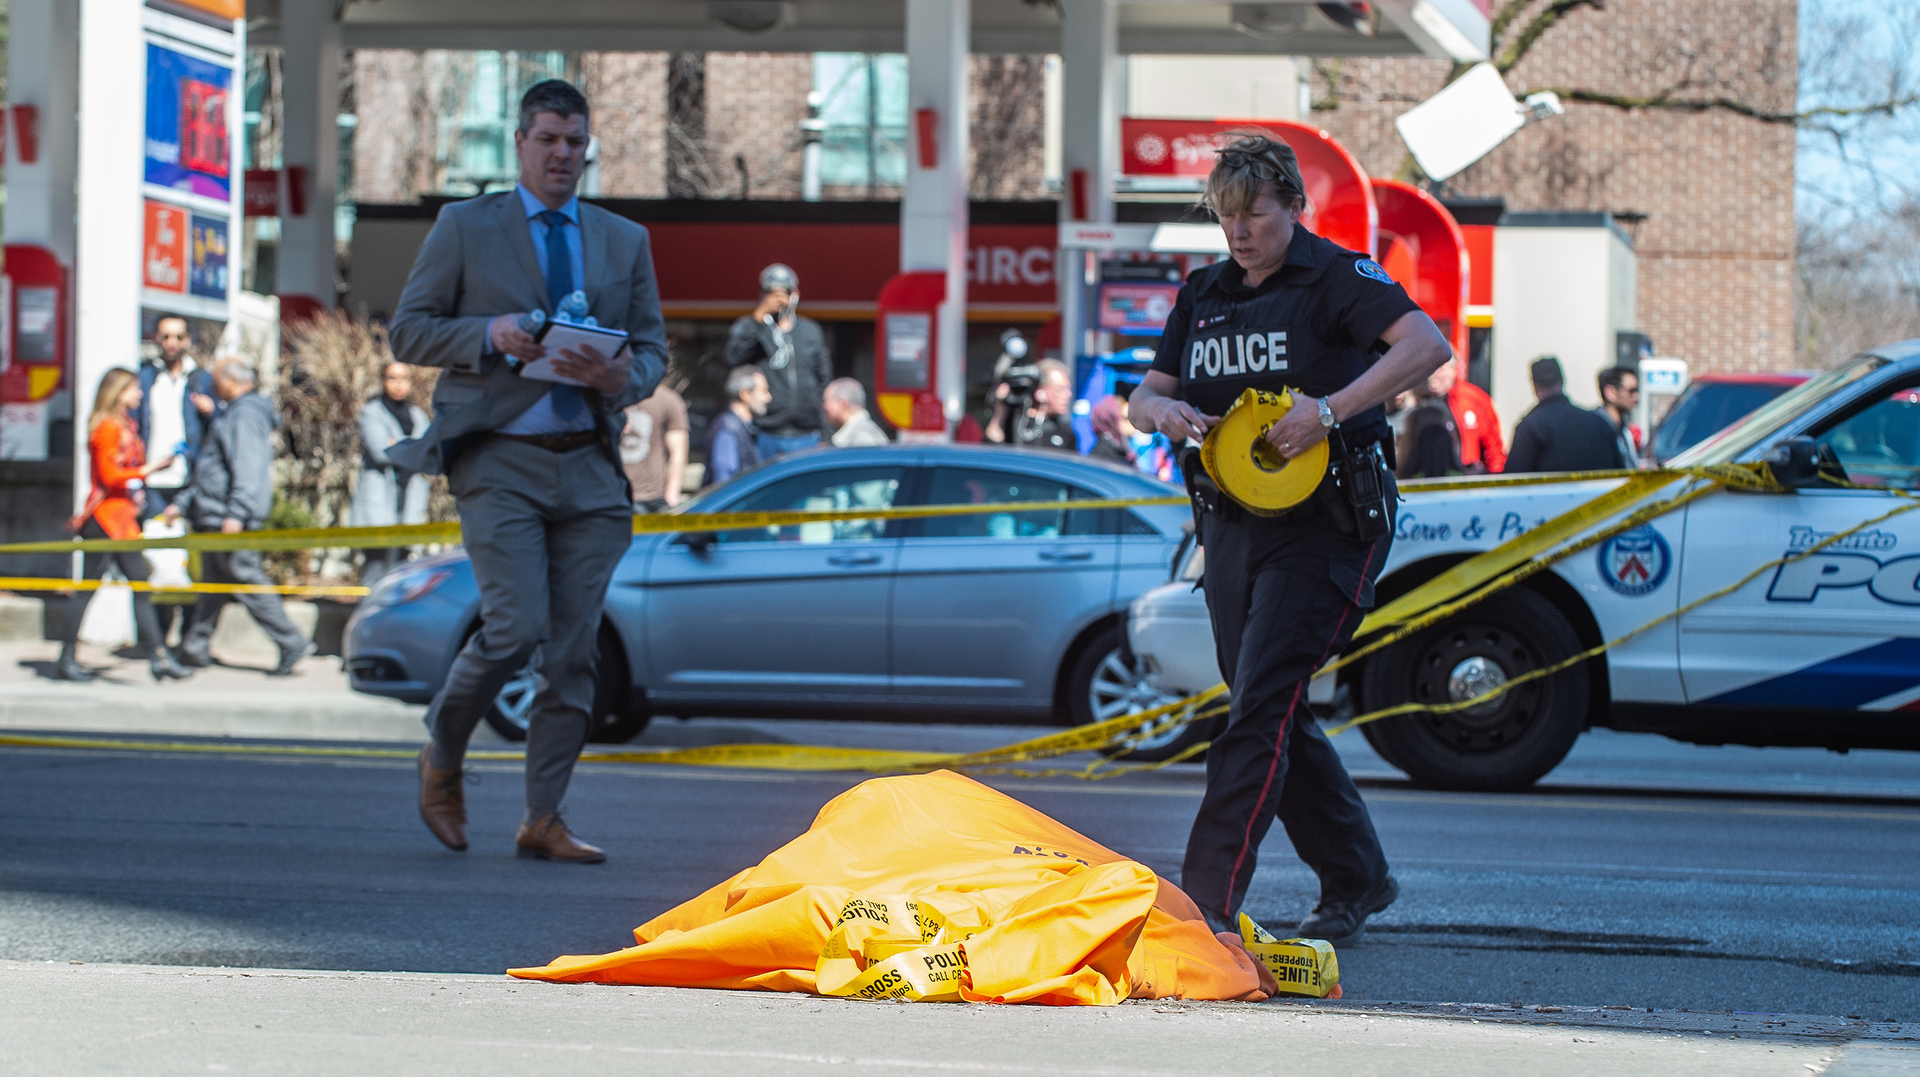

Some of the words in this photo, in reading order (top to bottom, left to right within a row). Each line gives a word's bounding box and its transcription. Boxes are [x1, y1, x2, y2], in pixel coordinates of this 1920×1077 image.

[1189, 331, 1288, 379] POLICE
[1396, 512, 1451, 541] Serve
[1462, 515, 1486, 541] &
[923, 950, 967, 970] POLIC
[860, 969, 902, 998] CROSS
[928, 971, 949, 983] CALL
[890, 981, 914, 999] (tips)
